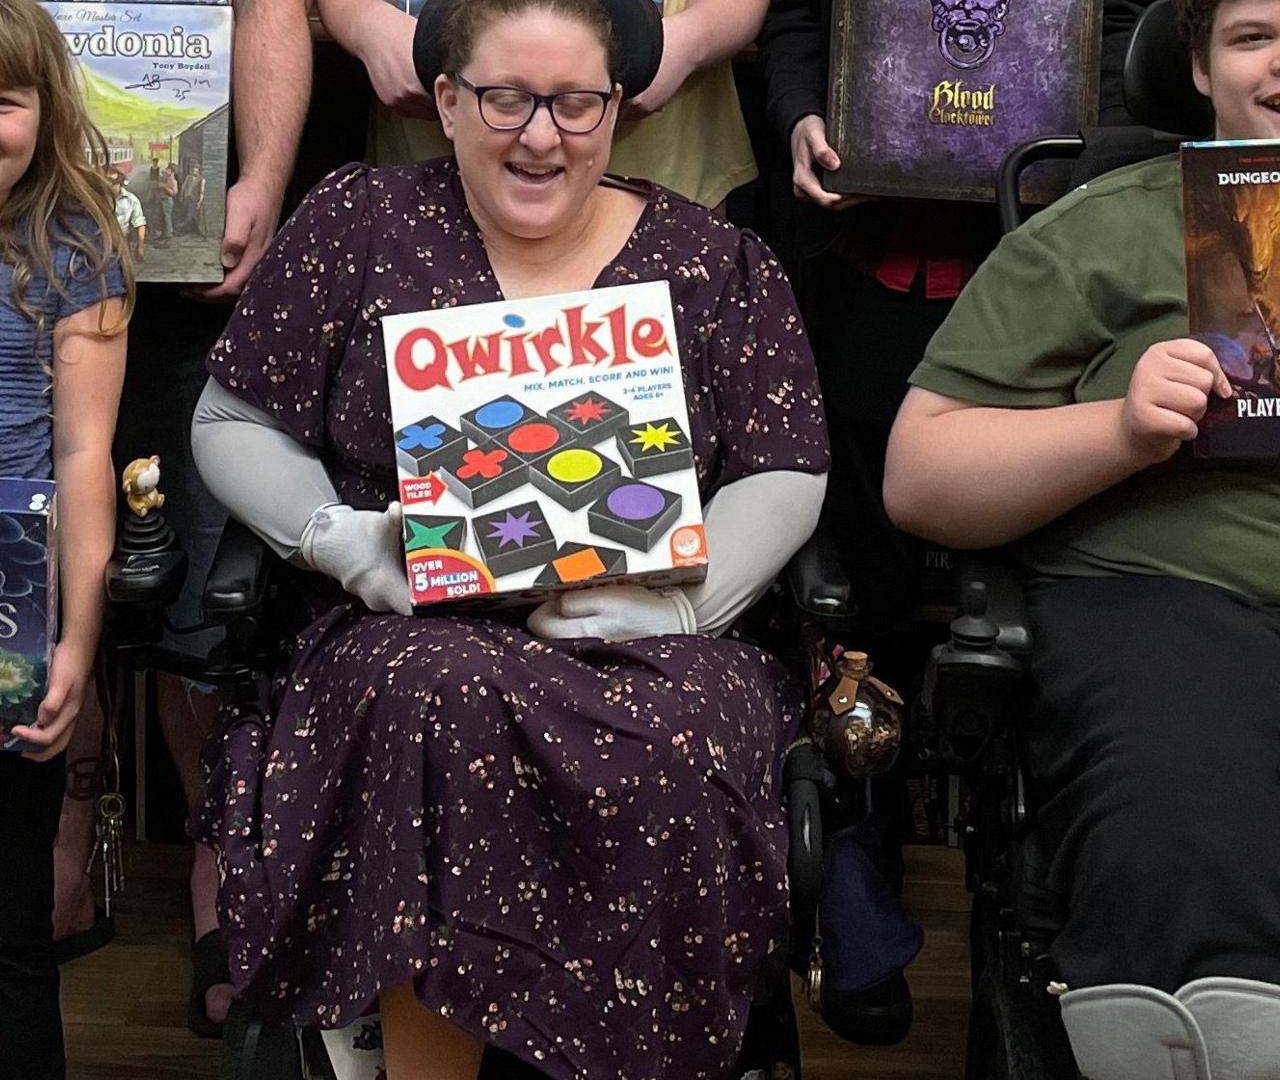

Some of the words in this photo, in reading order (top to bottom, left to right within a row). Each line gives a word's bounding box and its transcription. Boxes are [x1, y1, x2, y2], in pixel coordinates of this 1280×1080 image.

[151, 61, 175, 72] Tony
[177, 61, 212, 71] Boydell
[928, 79, 997, 111] Blood
[393, 303, 674, 393] Qwirkle
[523, 381, 547, 393] MIX,
[547, 376, 587, 391] MATCH,
[588, 371, 623, 385] SCORE
[624, 368, 649, 381] AND
[648, 366, 675, 378] WIN!
[637, 382, 673, 395] PLAYERS
[632, 392, 654, 402] AGES
[403, 480, 433, 492] WOOD
[404, 487, 433, 500] TILES!
[410, 558, 444, 573] OVER
[413, 572, 430, 593] 5
[429, 570, 479, 587] MILLION
[445, 581, 481, 598] SOLD!
